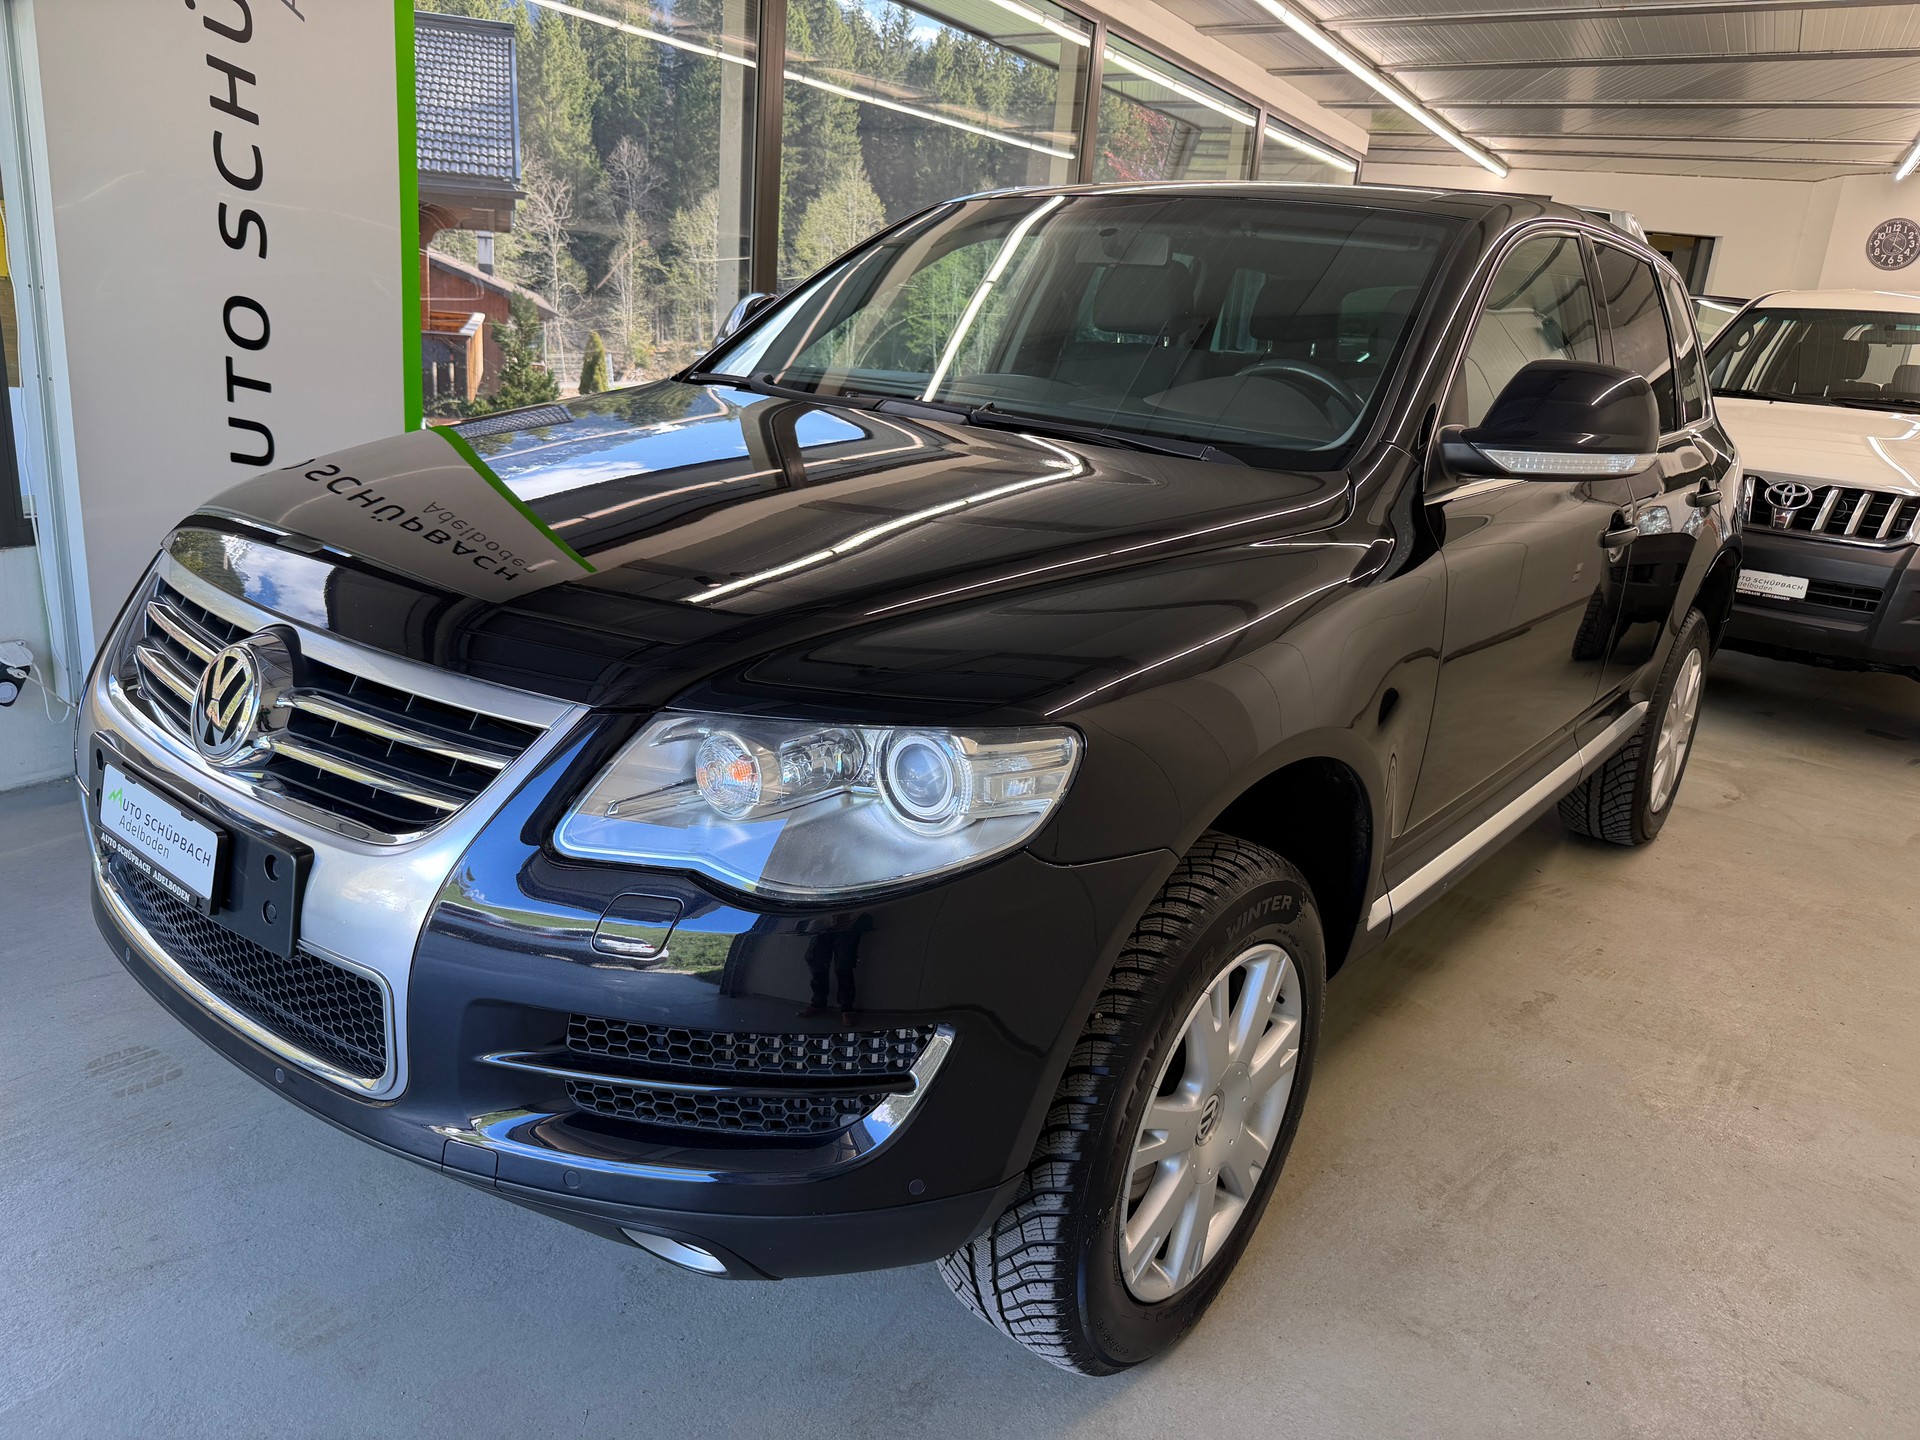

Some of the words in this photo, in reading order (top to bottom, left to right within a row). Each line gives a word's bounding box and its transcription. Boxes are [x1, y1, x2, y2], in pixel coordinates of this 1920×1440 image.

[1893, 224, 1902, 232] 12
[1904, 226, 1908, 234] 1
[1877, 232, 1886, 240] 10
[1909, 240, 1915, 248] 3
[1874, 247, 1880, 256] 8
[1903, 248, 1911, 256] 4
[1880, 254, 1887, 263] 7
[1887, 256, 1894, 264] 6
[1896, 254, 1904, 263] 5
[1752, 578, 1804, 590] SCHÜPBACH
[118, 815, 170, 859] Adelboden
[143, 813, 212, 867] SCHÜPBACH
[100, 832, 117, 849] AUTO
[117, 843, 152, 874] SCHÜPBACH
[152, 870, 191, 902] ADELBODEN
[1224, 893, 1293, 945] WINTER
